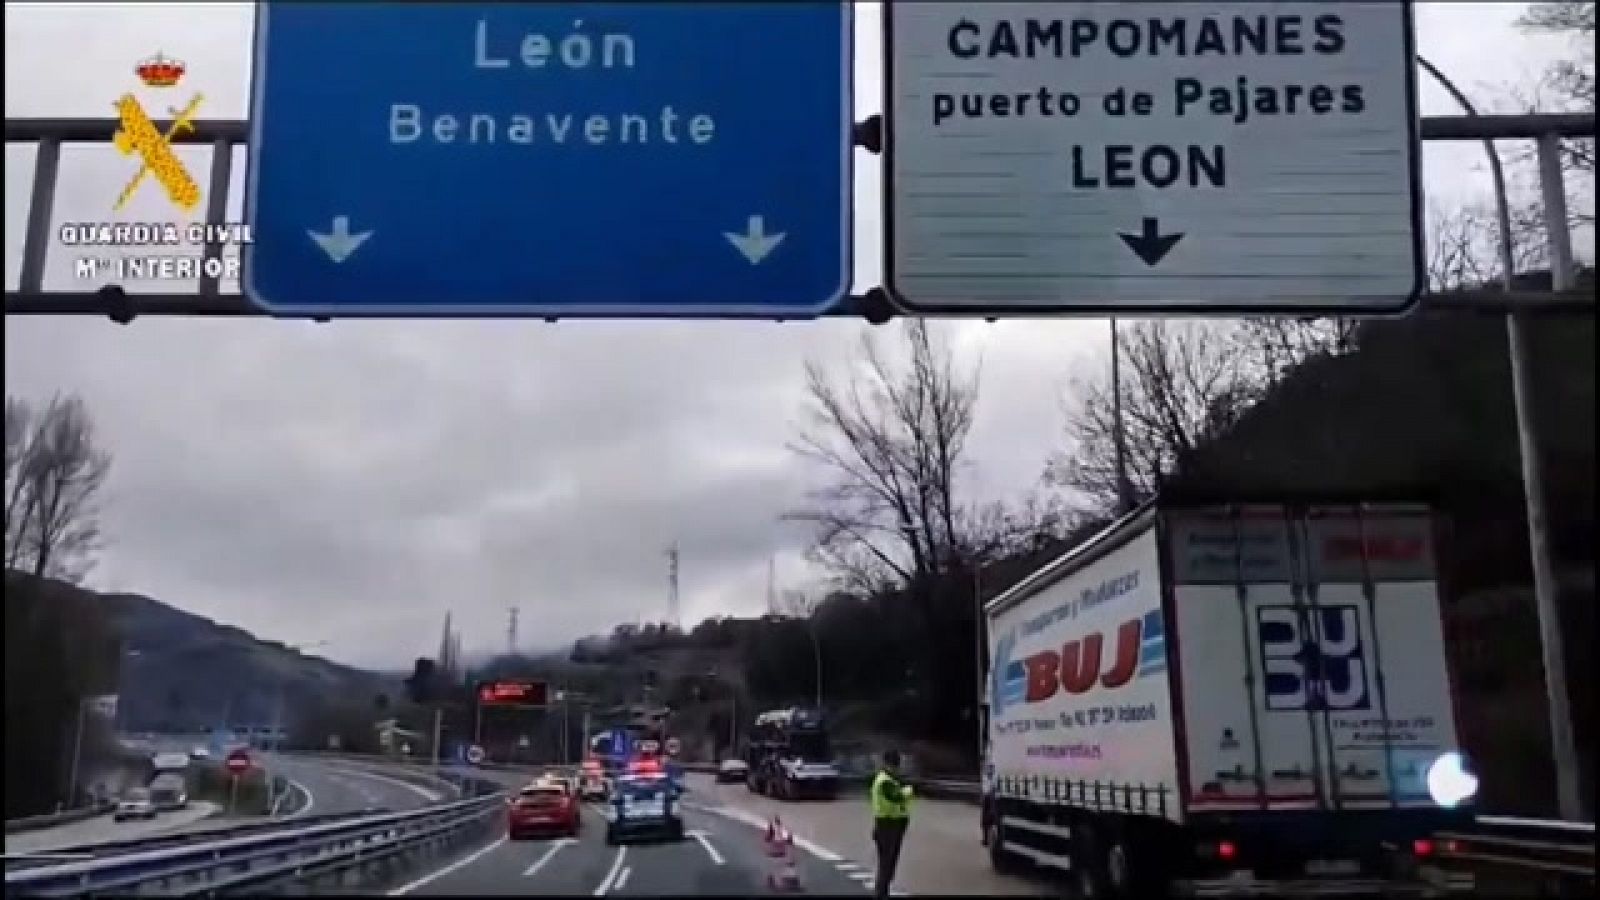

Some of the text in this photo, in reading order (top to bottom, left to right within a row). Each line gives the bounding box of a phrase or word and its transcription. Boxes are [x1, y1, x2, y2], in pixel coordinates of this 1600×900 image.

[474, 19, 637, 70] León
[947, 14, 1346, 59] CAMPOMANES
[389, 104, 717, 144] Benavente
[933, 76, 1366, 125] puerto de Pajares
[1071, 145, 1227, 189] LEON
[1024, 618, 1141, 703] BUJ
